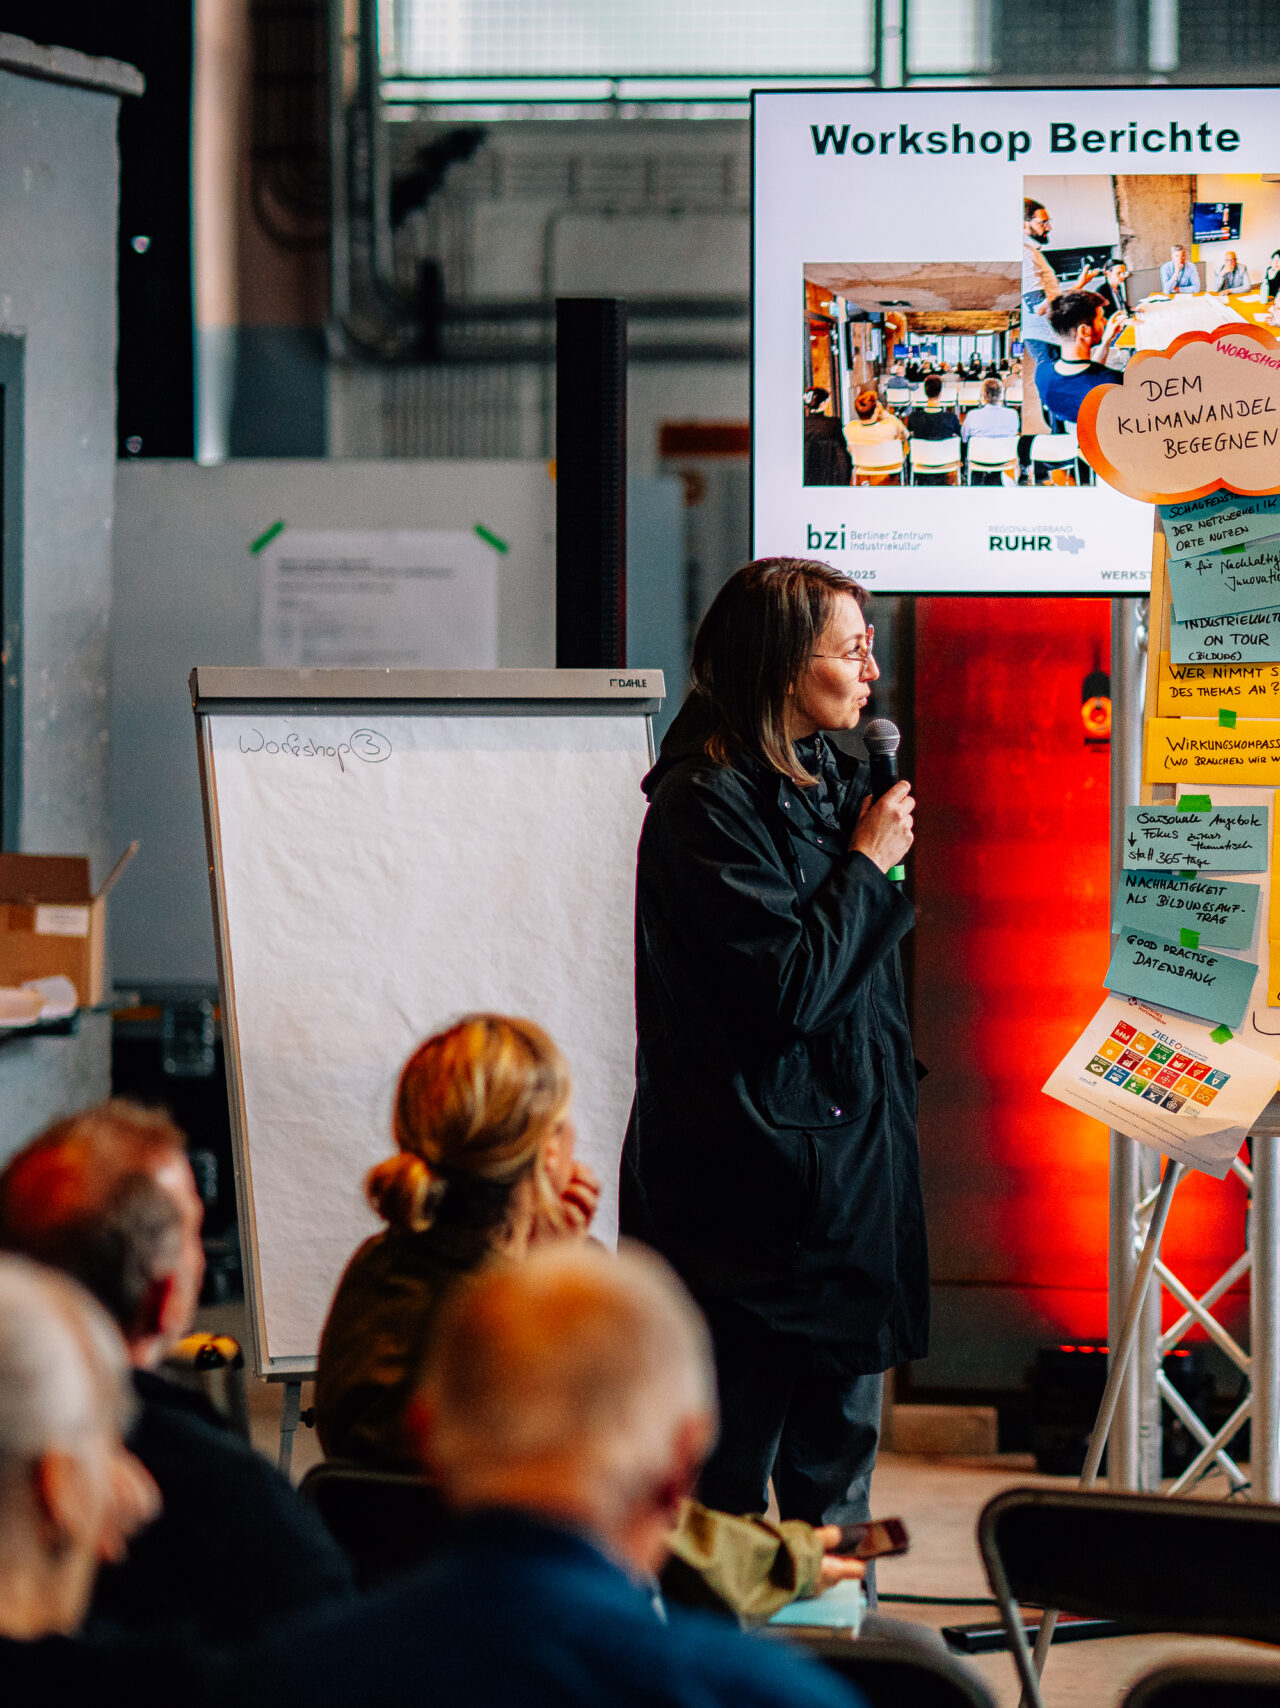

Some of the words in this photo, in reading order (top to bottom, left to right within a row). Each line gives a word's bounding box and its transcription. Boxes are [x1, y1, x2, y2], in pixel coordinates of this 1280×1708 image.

[810, 123, 1032, 162] Workshop
[1049, 121, 1241, 153] Berichte
[1140, 375, 1203, 402] DEM
[1163, 428, 1279, 459] BEGEGNEN
[807, 523, 846, 551] bzi
[850, 530, 890, 541] Berliner
[892, 530, 934, 541] Zentrum
[1172, 521, 1194, 537] DER
[850, 542, 922, 552] Industriekultur
[989, 535, 1053, 552] RUHR
[1175, 537, 1205, 552] ORTE
[1209, 526, 1249, 542] NUTZEN
[1204, 635, 1224, 647] ON
[1230, 633, 1271, 647] TOUR
[1169, 665, 1206, 680] WER
[618, 678, 648, 688] DAHLE
[1169, 686, 1193, 698] DES
[1199, 686, 1242, 697] THEMAS
[1248, 685, 1266, 695] AN
[239, 728, 350, 773] Workshop
[1194, 756, 1244, 766] BRAUCHEN
[1156, 851, 1183, 865] 365
[1126, 875, 1227, 896] NACHHALTIGKEIT
[1126, 893, 1147, 905] ALS
[1196, 912, 1228, 925] TRAG
[1127, 935, 1158, 951] GOOD
[1132, 951, 1217, 987] DATENBANK
[1151, 1029, 1176, 1047] ZIELE
